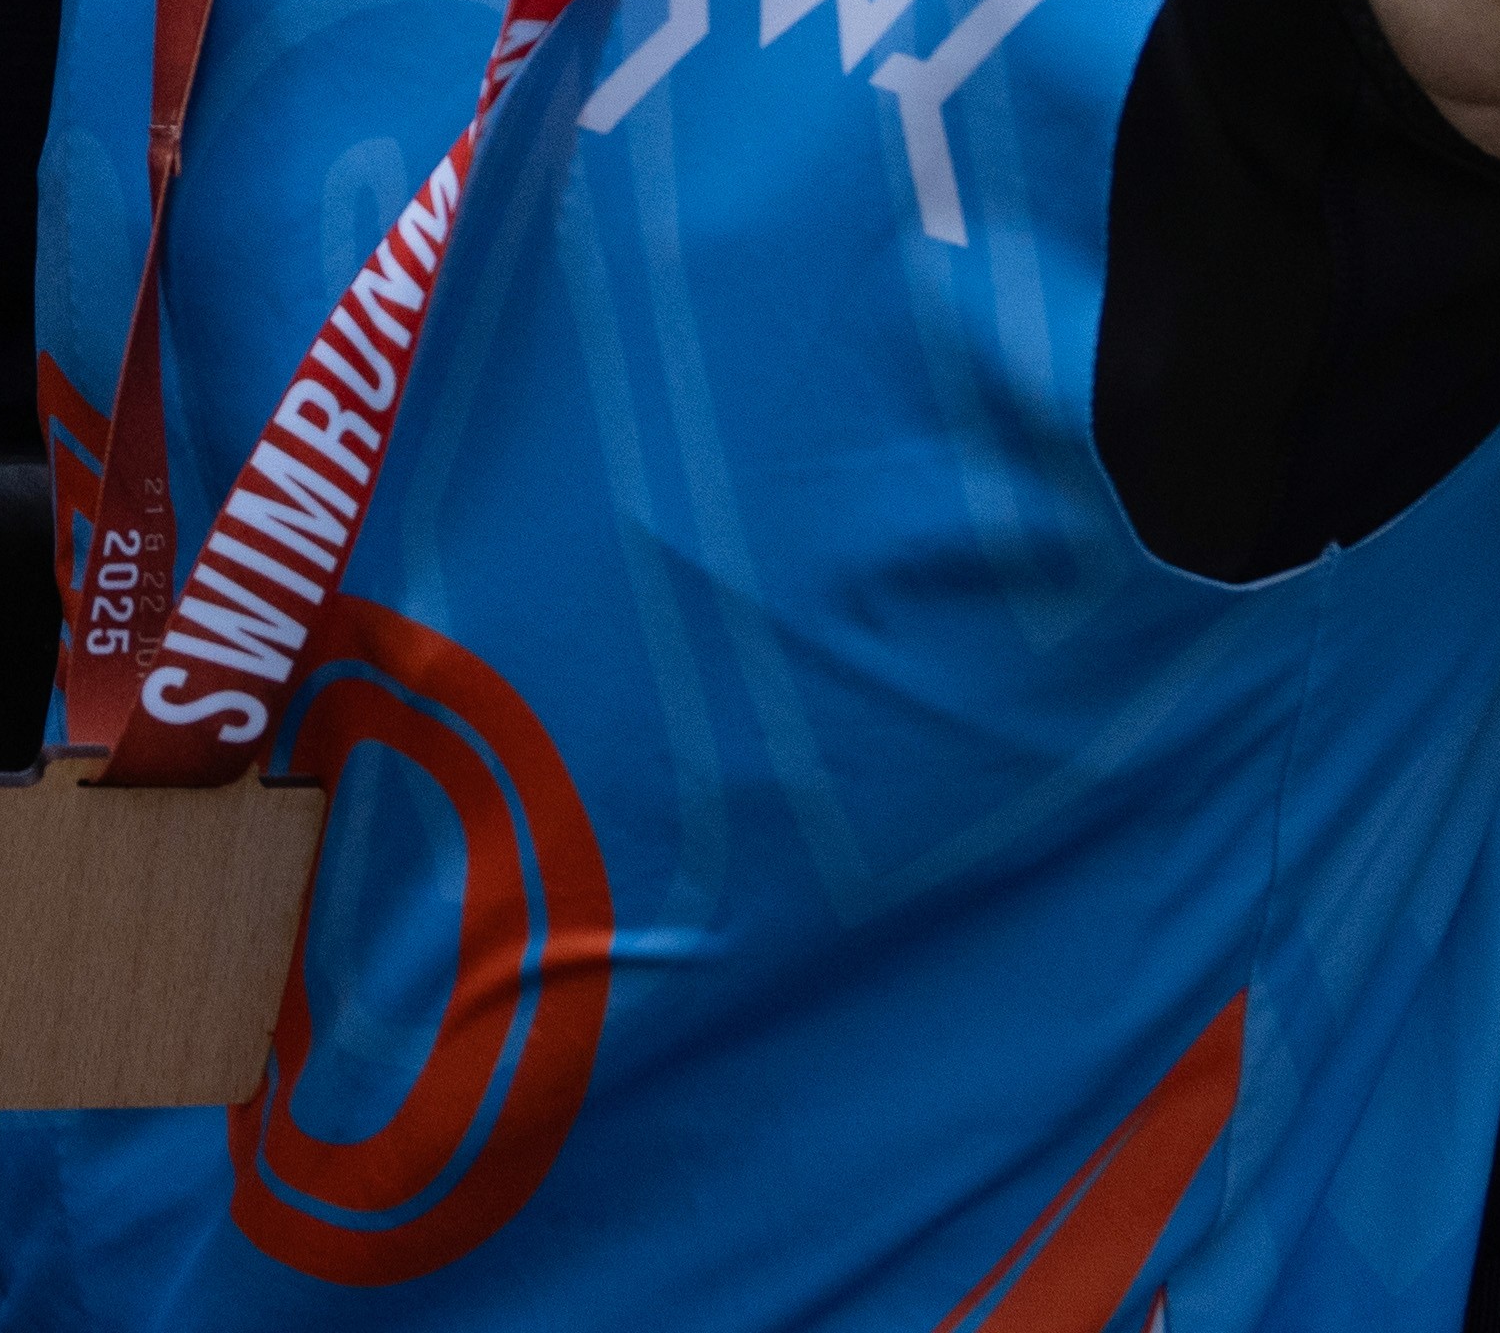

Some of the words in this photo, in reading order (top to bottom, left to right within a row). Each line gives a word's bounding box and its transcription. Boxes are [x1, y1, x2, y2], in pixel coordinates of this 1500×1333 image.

[144, 477, 165, 515] 21
[86, 528, 142, 656] 2025
[139, 571, 167, 614] 22
